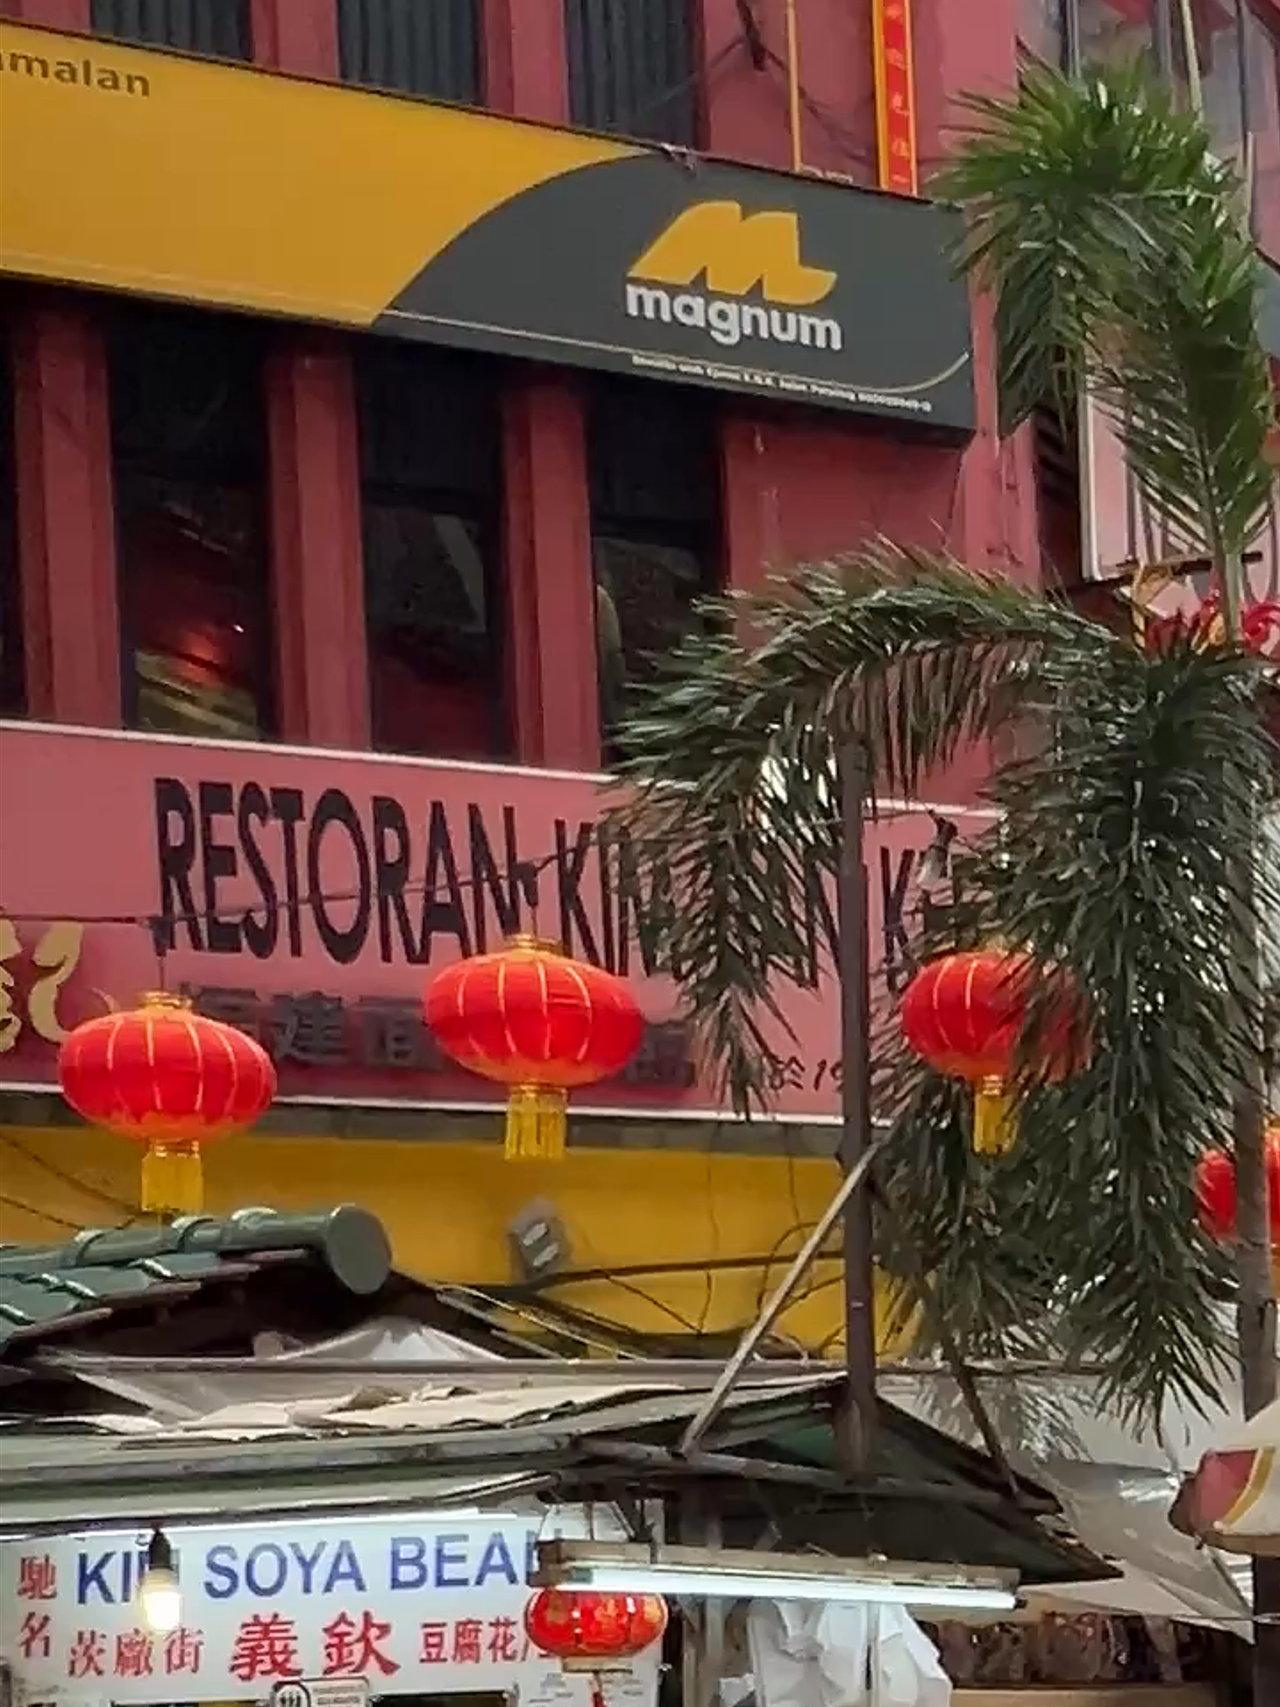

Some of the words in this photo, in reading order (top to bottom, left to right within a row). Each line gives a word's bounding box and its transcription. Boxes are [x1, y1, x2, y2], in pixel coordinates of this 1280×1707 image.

[0, 50, 150, 97] malan
[625, 283, 843, 350] magnum
[155, 777, 520, 964] RESTORAN
[203, 1539, 368, 1599] SOYA
